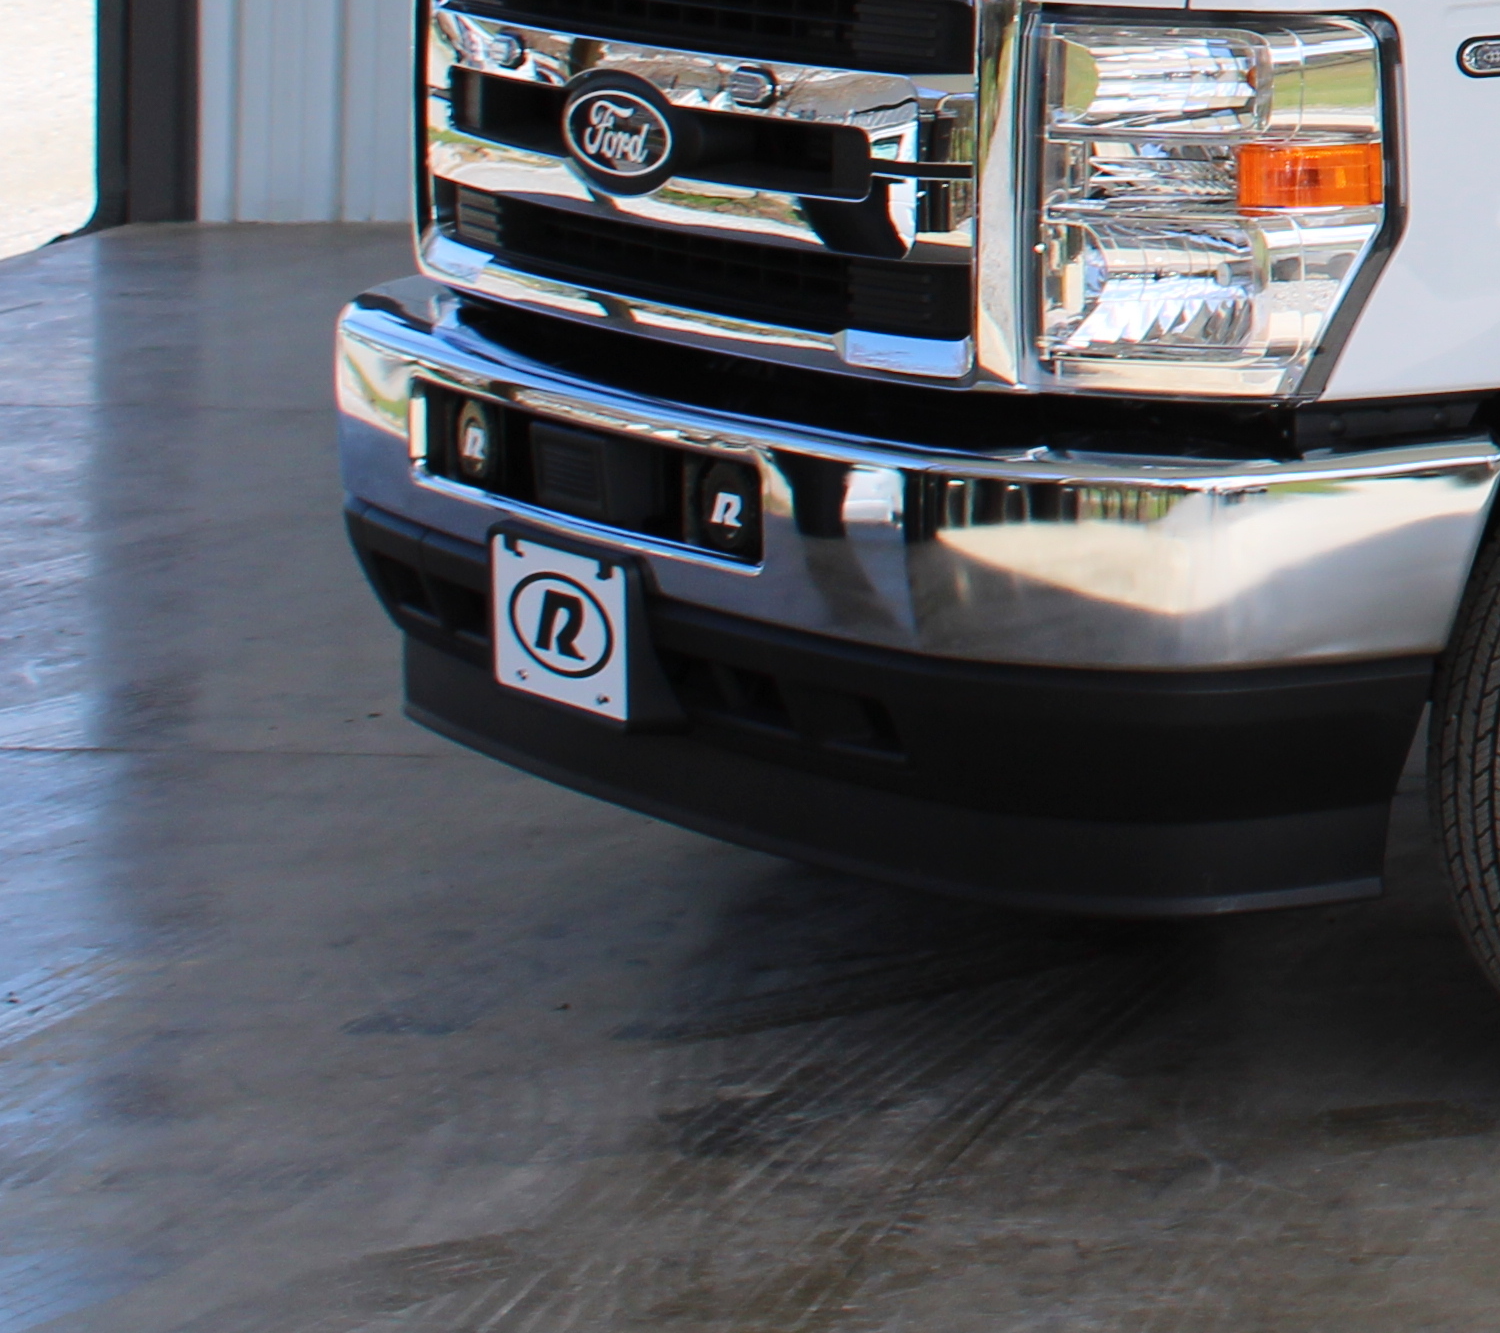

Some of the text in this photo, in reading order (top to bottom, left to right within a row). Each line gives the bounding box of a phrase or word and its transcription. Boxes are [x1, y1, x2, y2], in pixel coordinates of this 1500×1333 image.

[584, 100, 649, 164] Ford
[463, 426, 485, 459] R
[710, 491, 743, 529] R
[535, 589, 586, 662] R
